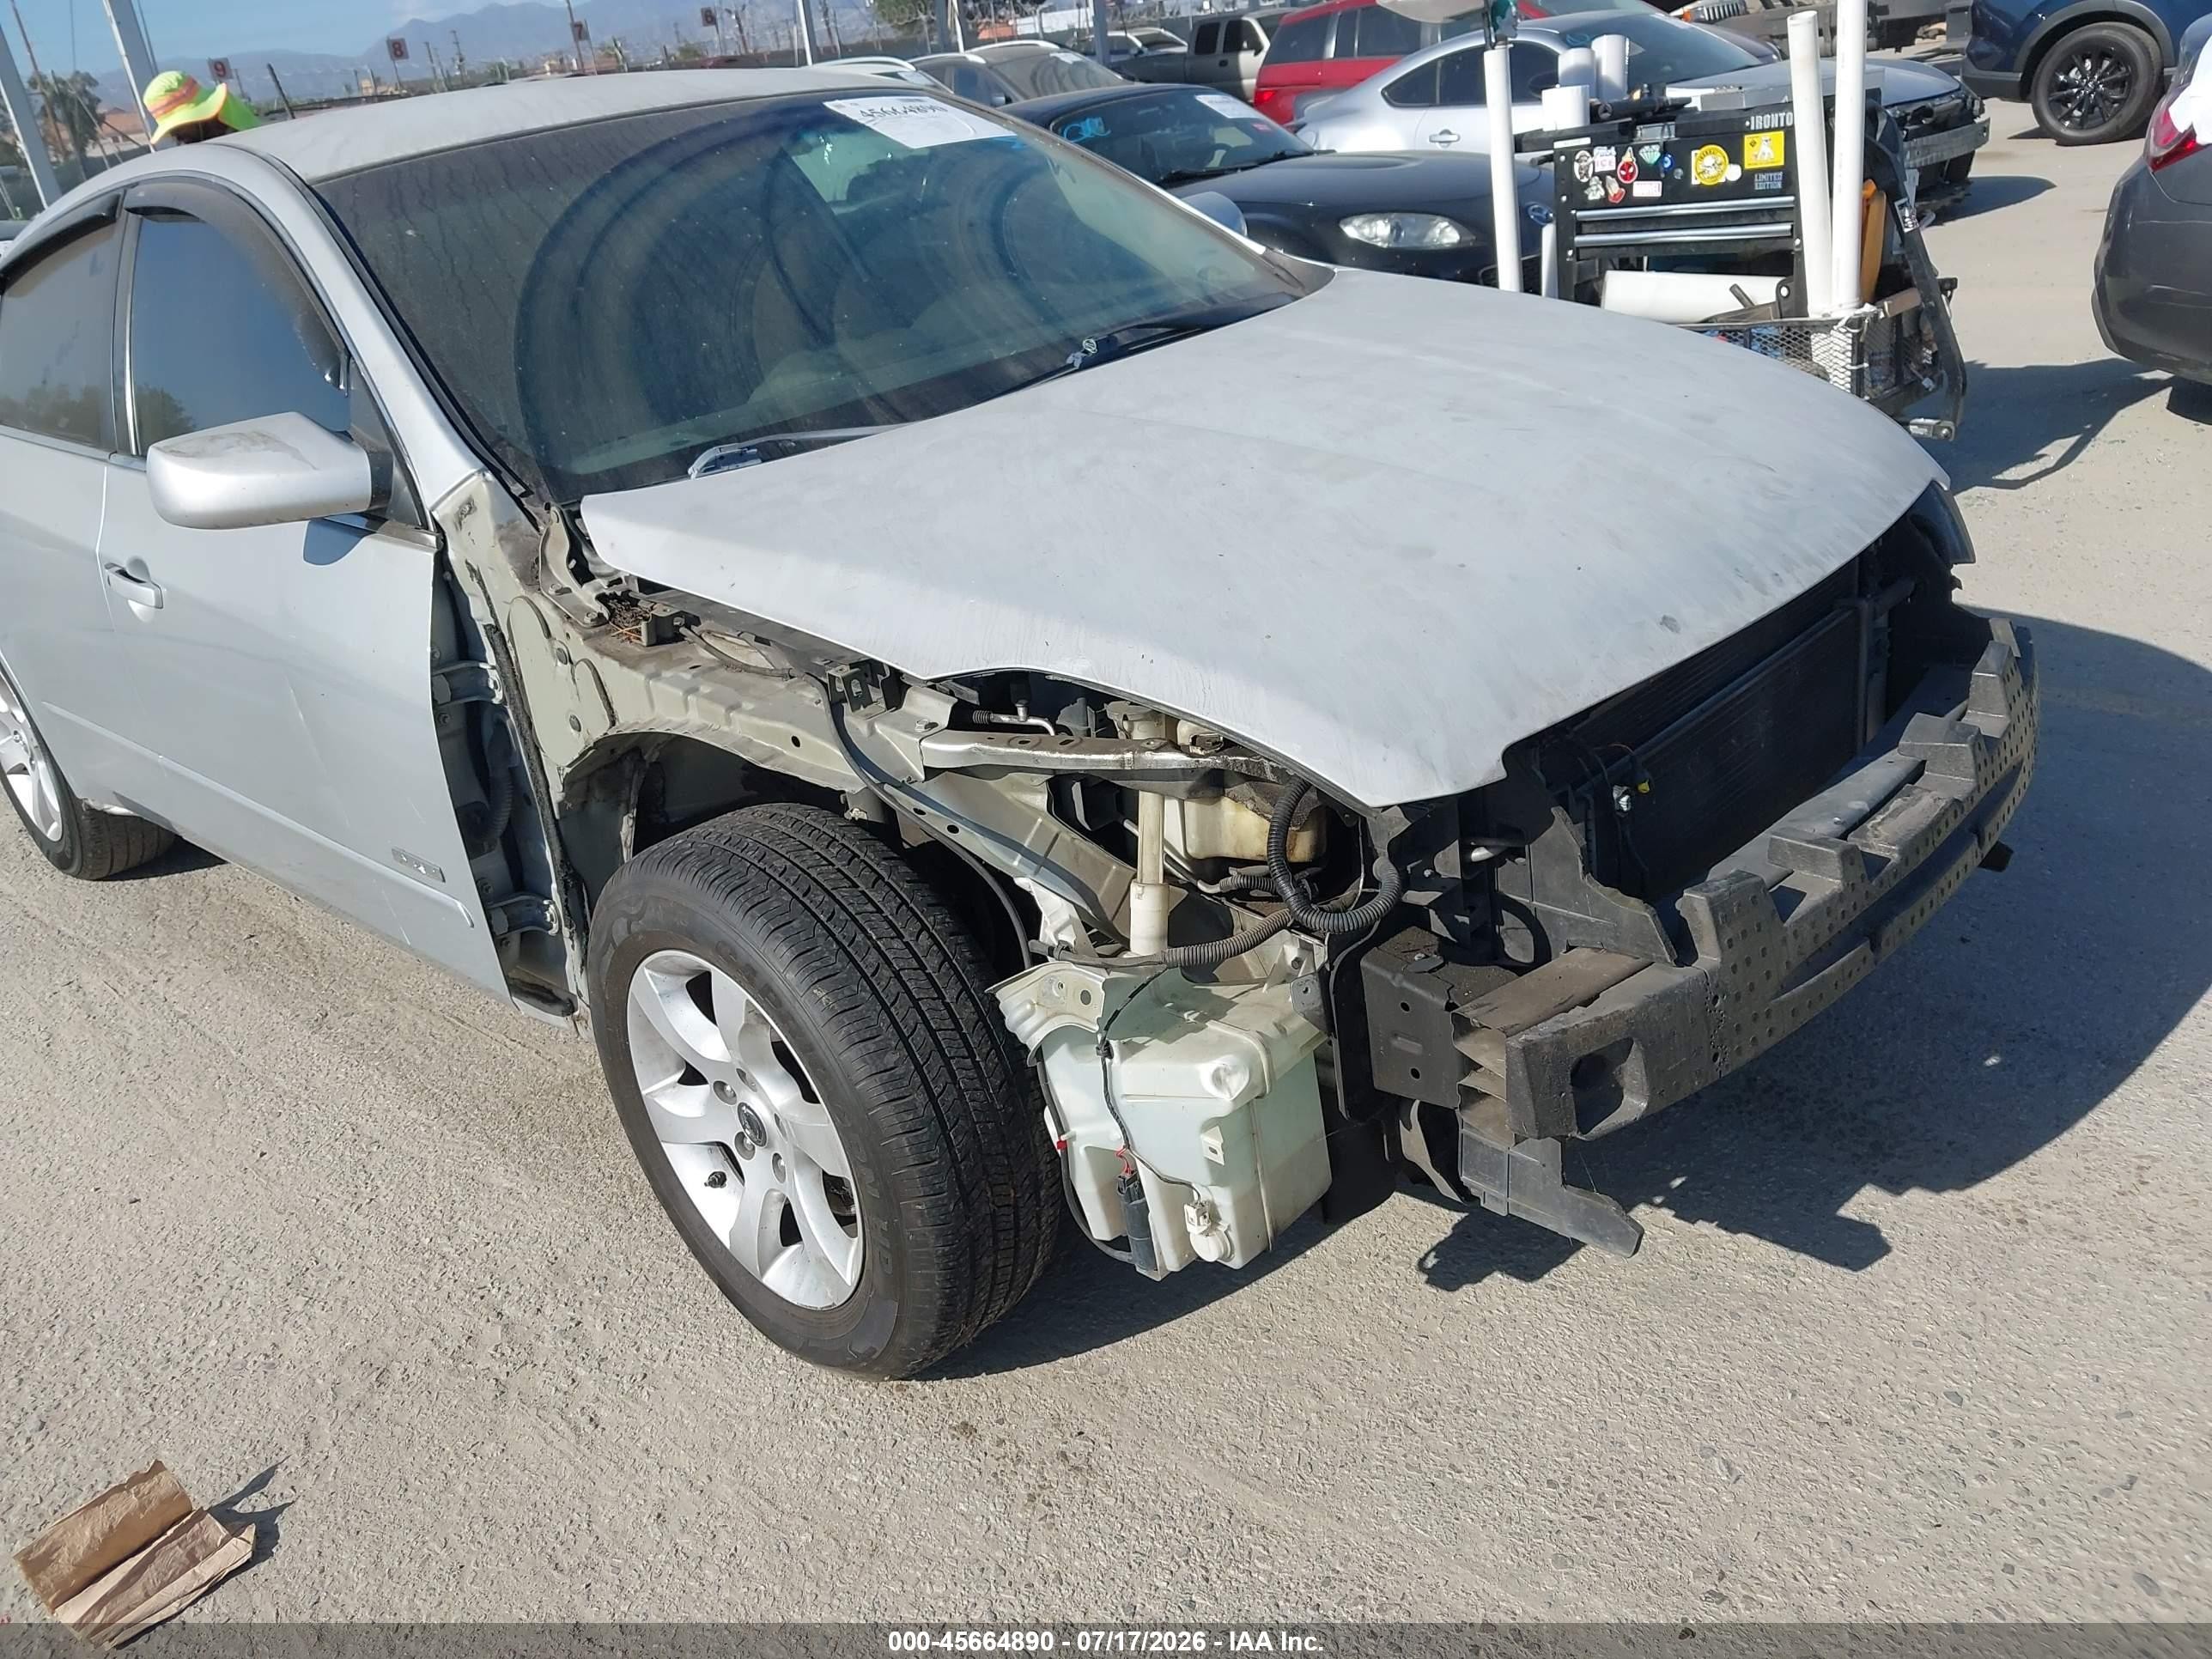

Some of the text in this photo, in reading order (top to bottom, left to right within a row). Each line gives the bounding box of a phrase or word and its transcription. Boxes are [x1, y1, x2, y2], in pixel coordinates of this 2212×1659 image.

[574, 21, 584, 40] 7
[392, 40, 404, 58] 8
[212, 61, 226, 78] 9
